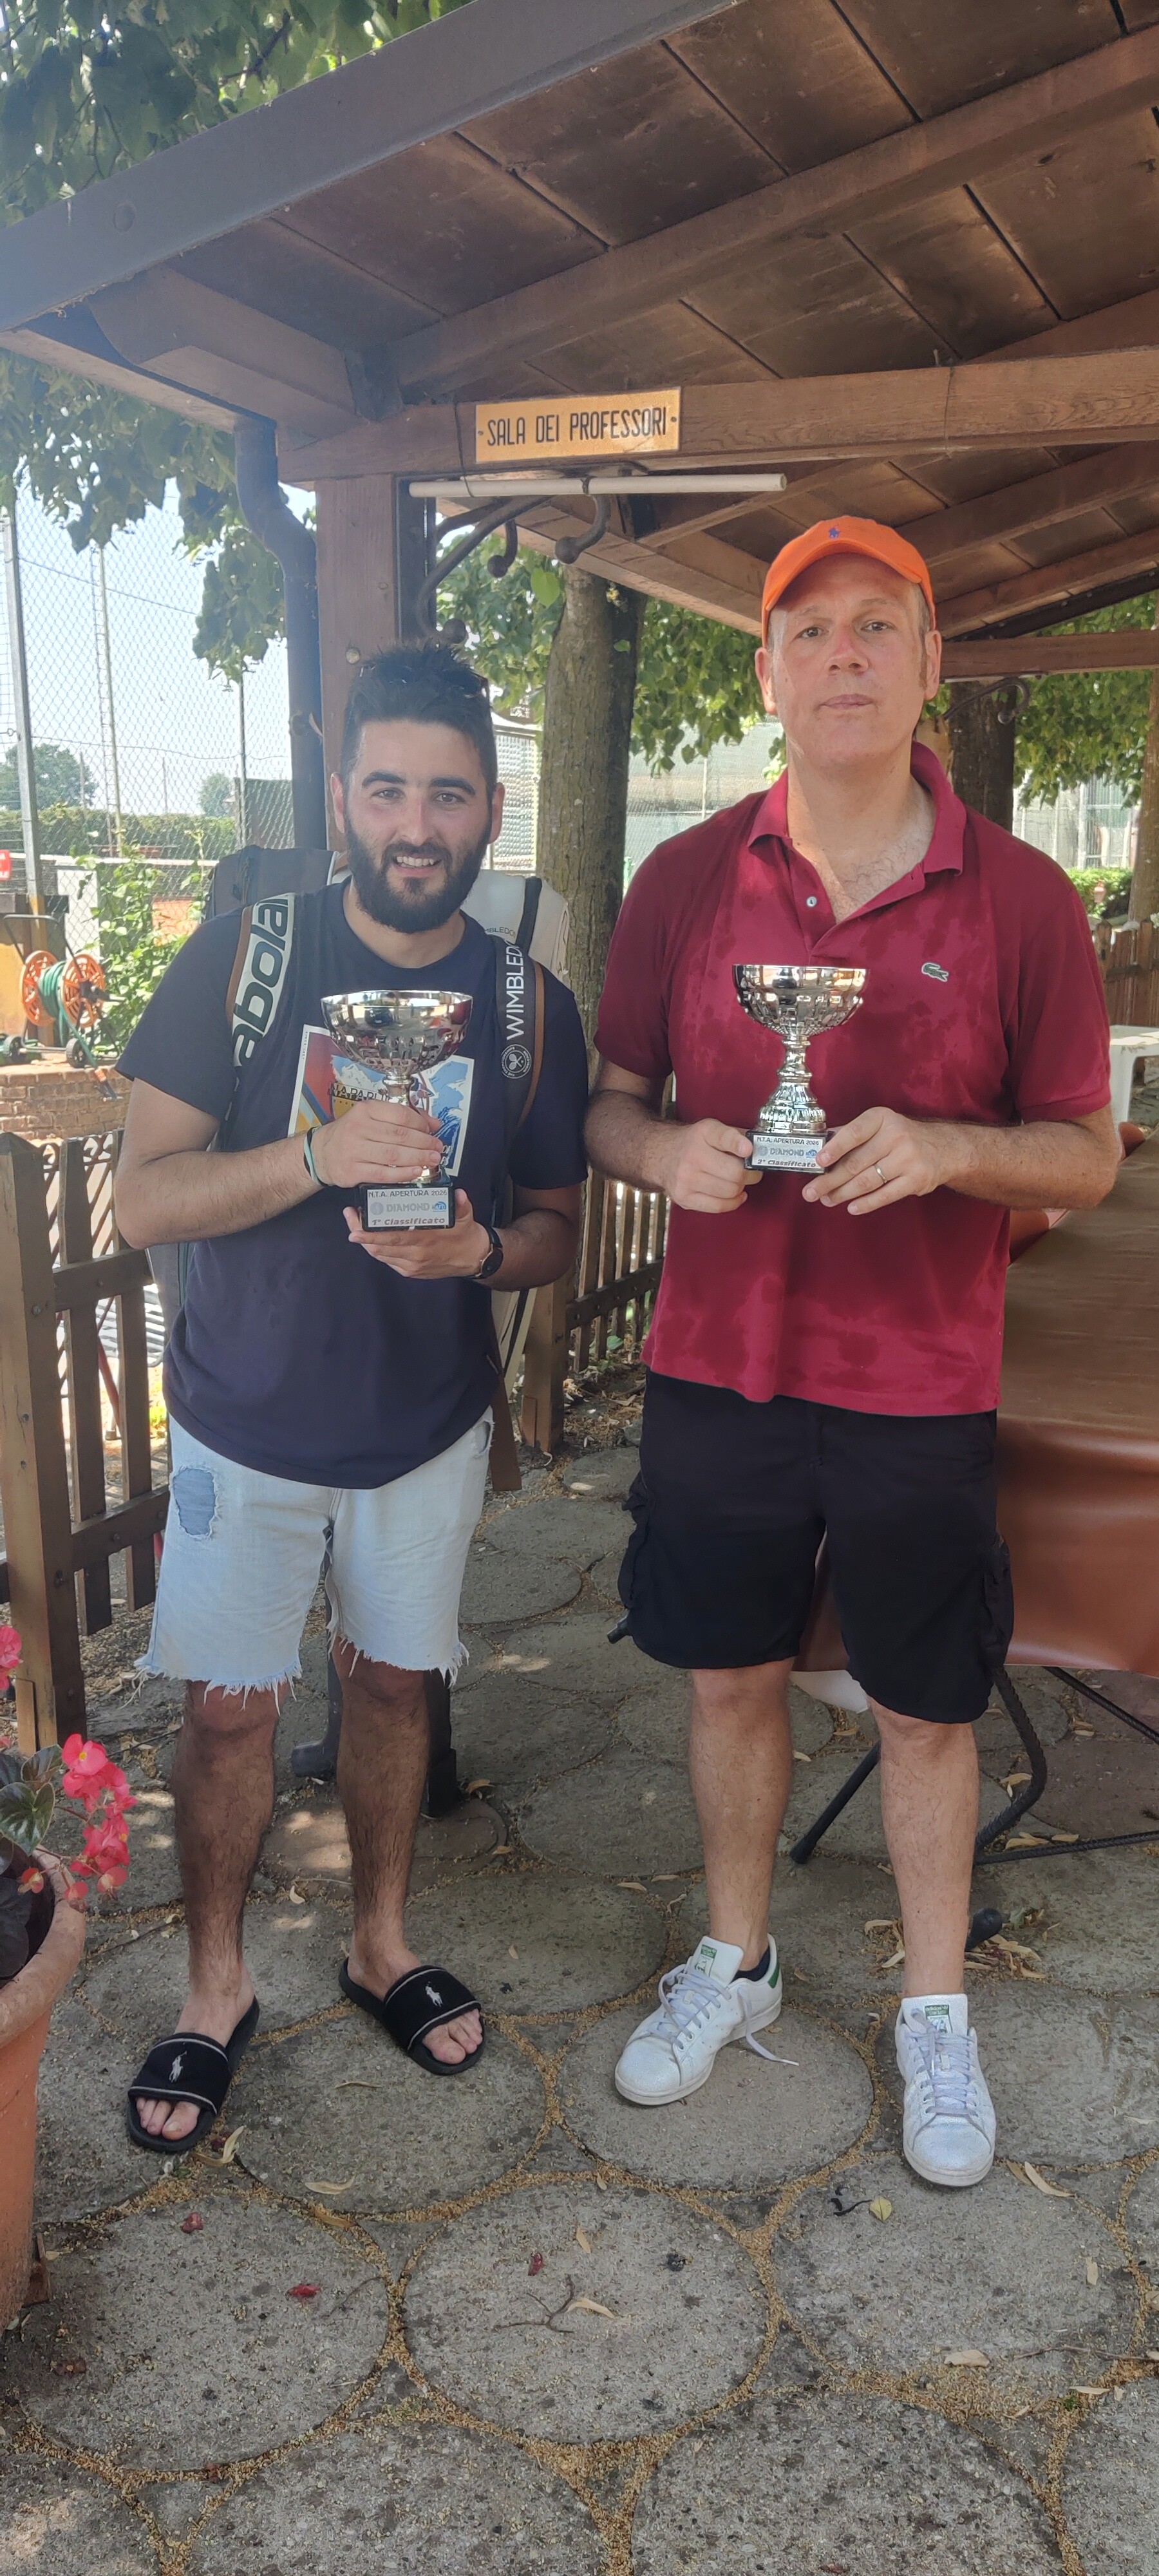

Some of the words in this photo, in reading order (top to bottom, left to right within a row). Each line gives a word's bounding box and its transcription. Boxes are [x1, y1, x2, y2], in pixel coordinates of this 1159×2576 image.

[487, 417, 526, 446] SALA
[536, 414, 560, 444] DEI
[569, 406, 667, 442] PROFESSORI
[769, 1148, 804, 1157] DIAMOND
[386, 1202, 430, 1213] DIAMOND
[384, 1217, 446, 1226] Classificato
